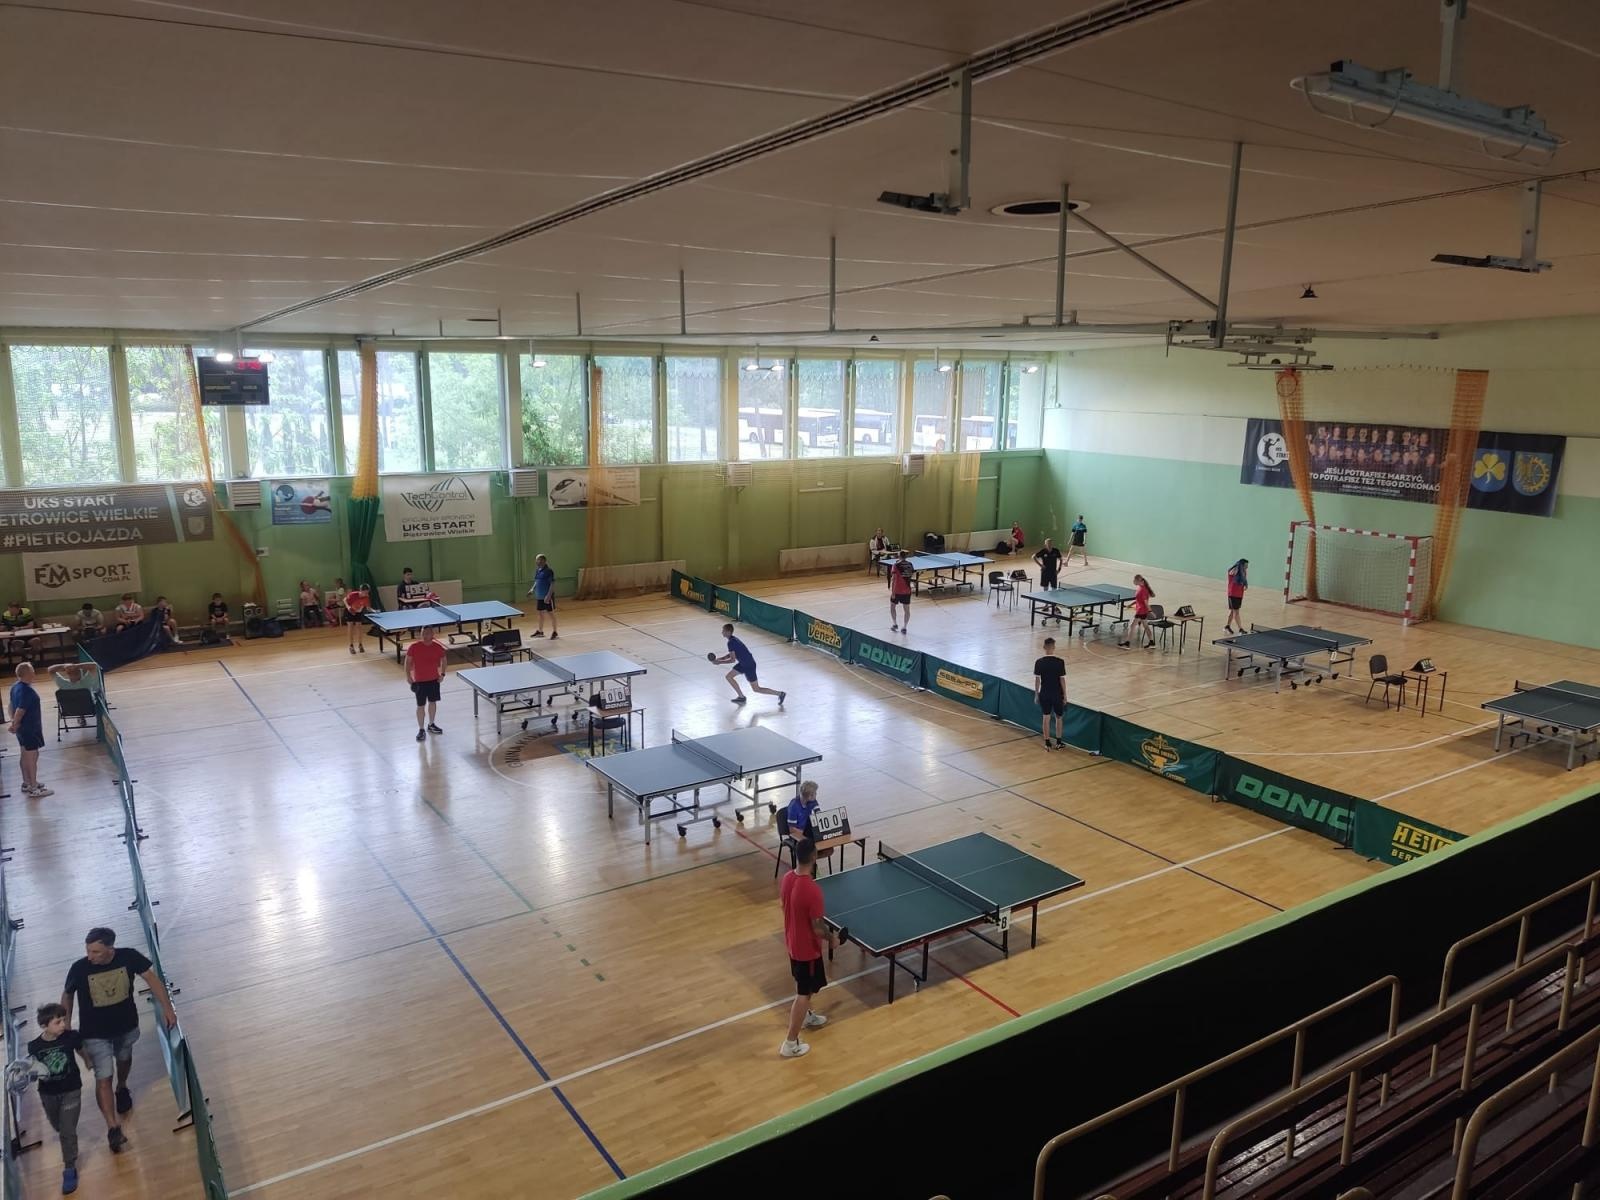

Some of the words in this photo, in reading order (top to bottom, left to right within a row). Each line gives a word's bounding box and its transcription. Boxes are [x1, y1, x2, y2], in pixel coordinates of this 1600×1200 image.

[1309, 472, 1319, 480] TO
[1319, 473, 1361, 483] POTRAFISZ
[1375, 479, 1398, 488] TEGO
[1324, 467, 1344, 475] JEŚLI
[1345, 469, 1386, 479] POTRAFISZ
[24, 496, 60, 509] UKS
[63, 493, 117, 507] START
[92, 506, 158, 522] WIELKIE
[402, 523, 430, 532] UKS
[433, 520, 475, 530] START
[3, 528, 143, 547] #PIETROJAZDA
[808, 622, 842, 648] Venezia
[859, 642, 913, 674] DONIC
[1235, 774, 1355, 832] DONIC
[818, 816, 830, 831] 10
[832, 814, 839, 826] 0
